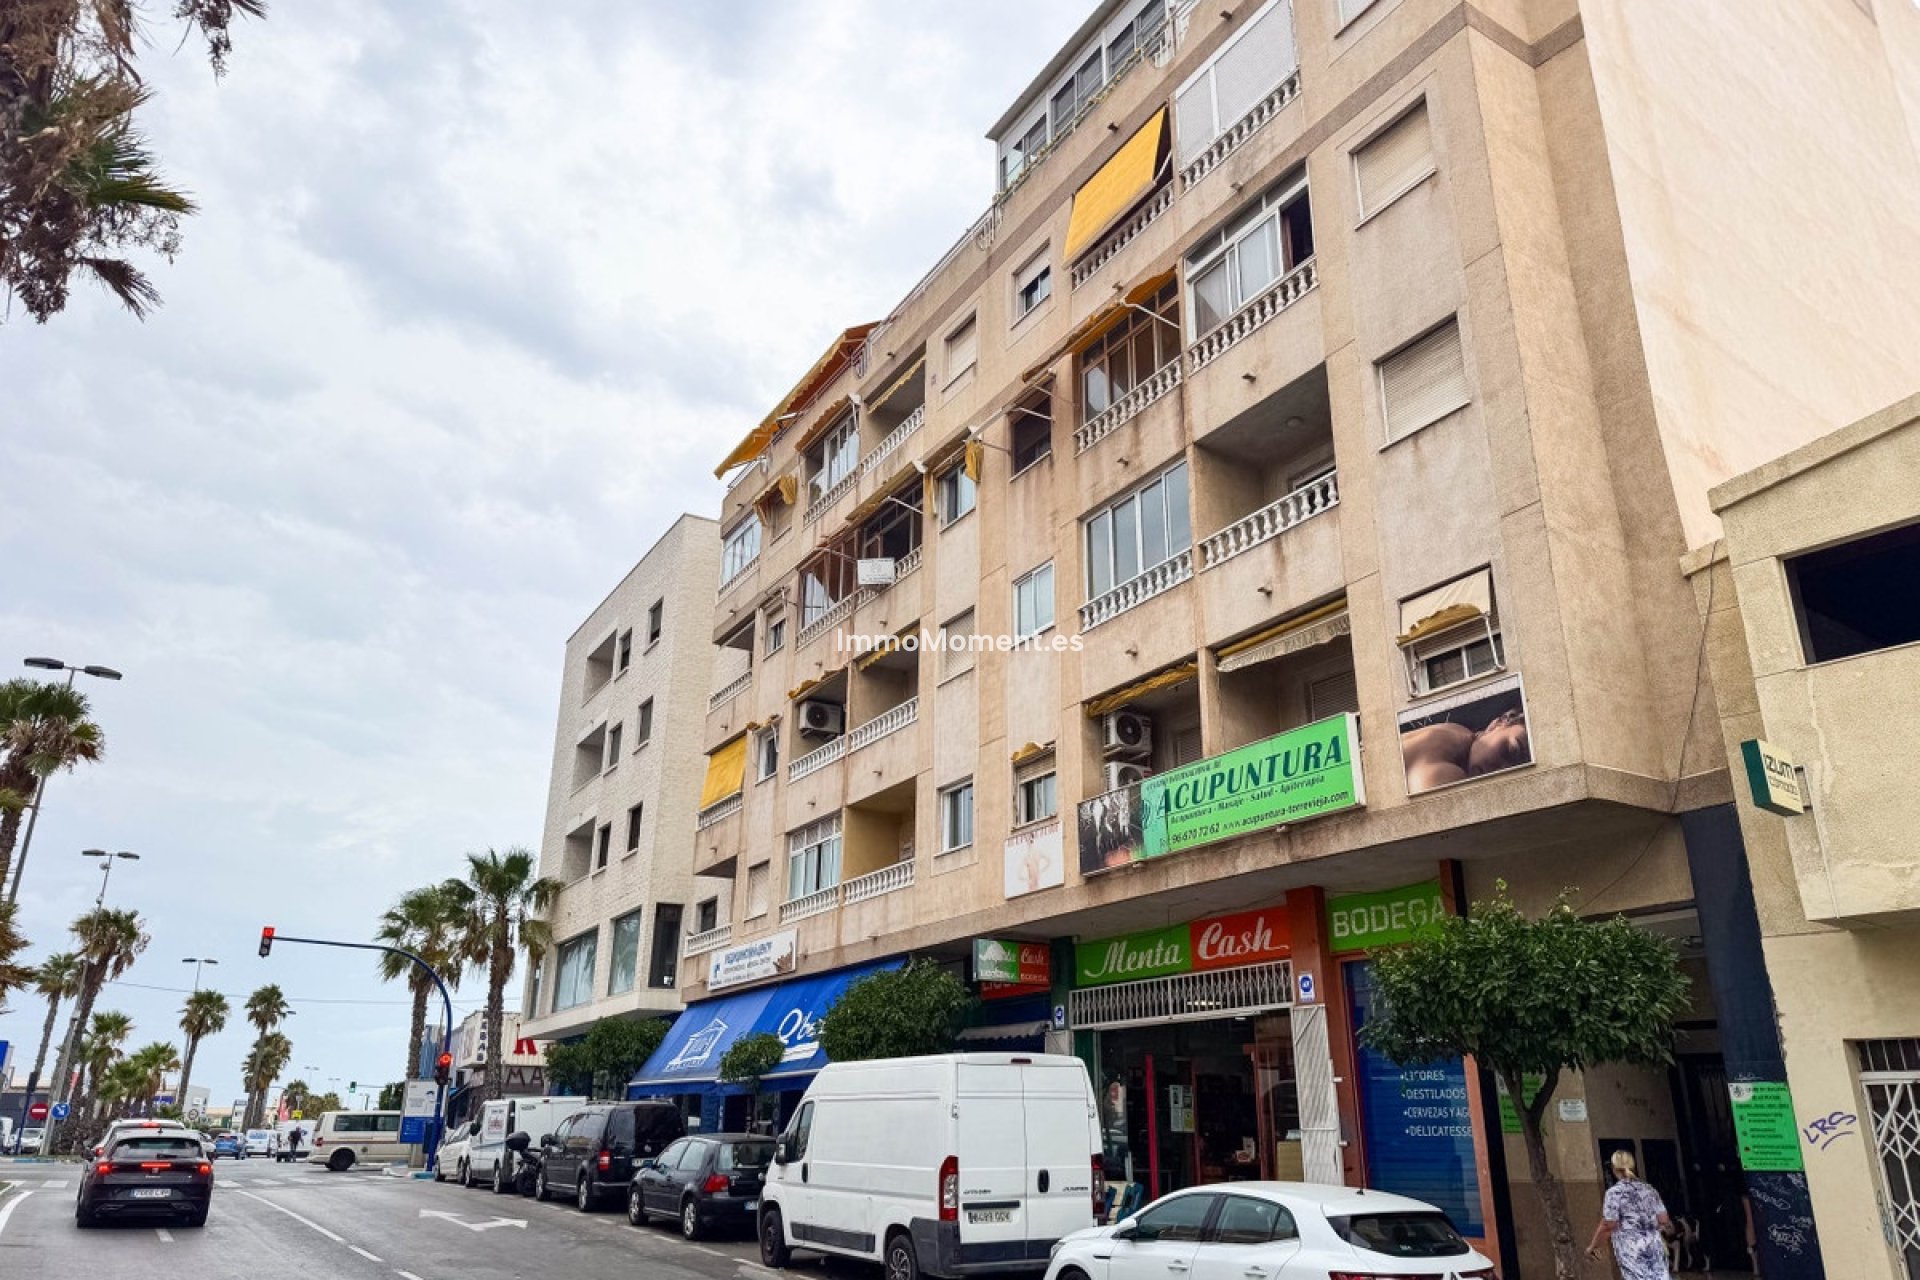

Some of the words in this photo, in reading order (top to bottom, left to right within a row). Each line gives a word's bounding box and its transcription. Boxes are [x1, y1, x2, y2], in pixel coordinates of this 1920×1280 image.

[1157, 735, 1342, 815] ACUPUNTURA
[1251, 786, 1274, 801] Salud
[1332, 895, 1446, 937] BODEGA
[1084, 937, 1183, 978] Menta
[1197, 916, 1290, 961] Cash
[1406, 1087, 1467, 1100] DESTILADOS
[1407, 1106, 1449, 1119] CERVEZAS
[1449, 1106, 1455, 1118] Y
